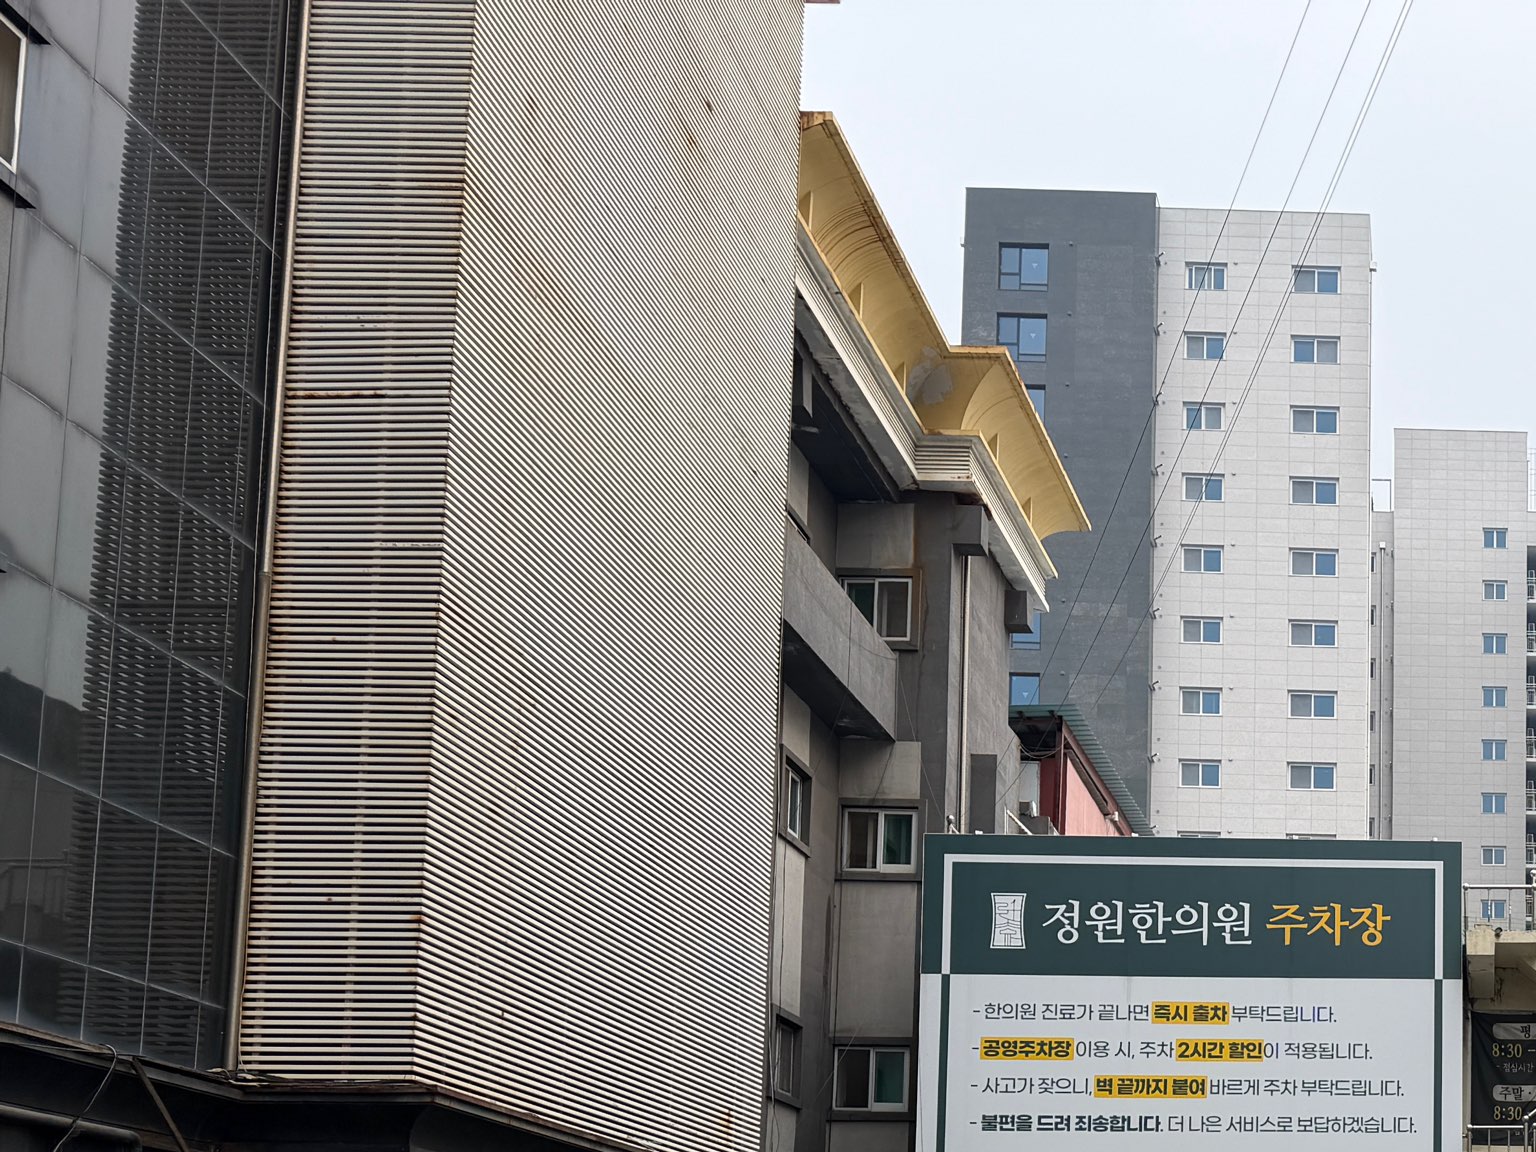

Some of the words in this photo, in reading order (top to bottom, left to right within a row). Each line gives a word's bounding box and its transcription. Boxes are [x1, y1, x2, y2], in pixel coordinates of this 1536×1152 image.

[1042, 900, 1252, 946] 정원한의원
[1266, 903, 1391, 946] 주차장
[984, 1003, 1036, 1020] 한의원
[1042, 1004, 1093, 1020] 진료가
[1098, 1004, 1149, 1021] 끝나면
[1154, 1005, 1188, 1021] 즉시
[1193, 1005, 1227, 1022] 출차
[1232, 1006, 1336, 1023] 부탁드립니다.
[983, 1040, 1071, 1057] 공영주차장
[1076, 1041, 1110, 1058] 이용
[1115, 1042, 1134, 1059] 시,
[1139, 1042, 1174, 1058] 주차
[1178, 1042, 1224, 1058] 2시간
[1284, 1042, 1373, 1060] 적용됩니다.
[1492, 1043, 1522, 1057] 8:30
[1503, 1063, 1534, 1072] 점심시간
[981, 1078, 1035, 1094] 사고가
[1038, 1078, 1092, 1095] 잦으니,
[1096, 1078, 1112, 1094] 벽
[1117, 1078, 1167, 1094] 끝까지
[1172, 1078, 1205, 1095] 붙여
[1210, 1079, 1259, 1095] 바르게
[1264, 1079, 1297, 1096] 주차
[1301, 1079, 1404, 1097] 부탁드립니다.
[1494, 1106, 1522, 1120] 8:30
[981, 1115, 1032, 1132] 불편을
[1037, 1115, 1070, 1132] 드려
[1075, 1115, 1163, 1132] 죄송합니다.
[1169, 1116, 1183, 1132] 더
[1189, 1116, 1222, 1132] 나은
[1226, 1116, 1293, 1133] 서비스로
[1297, 1117, 1417, 1133] 보답하겠습니다.
